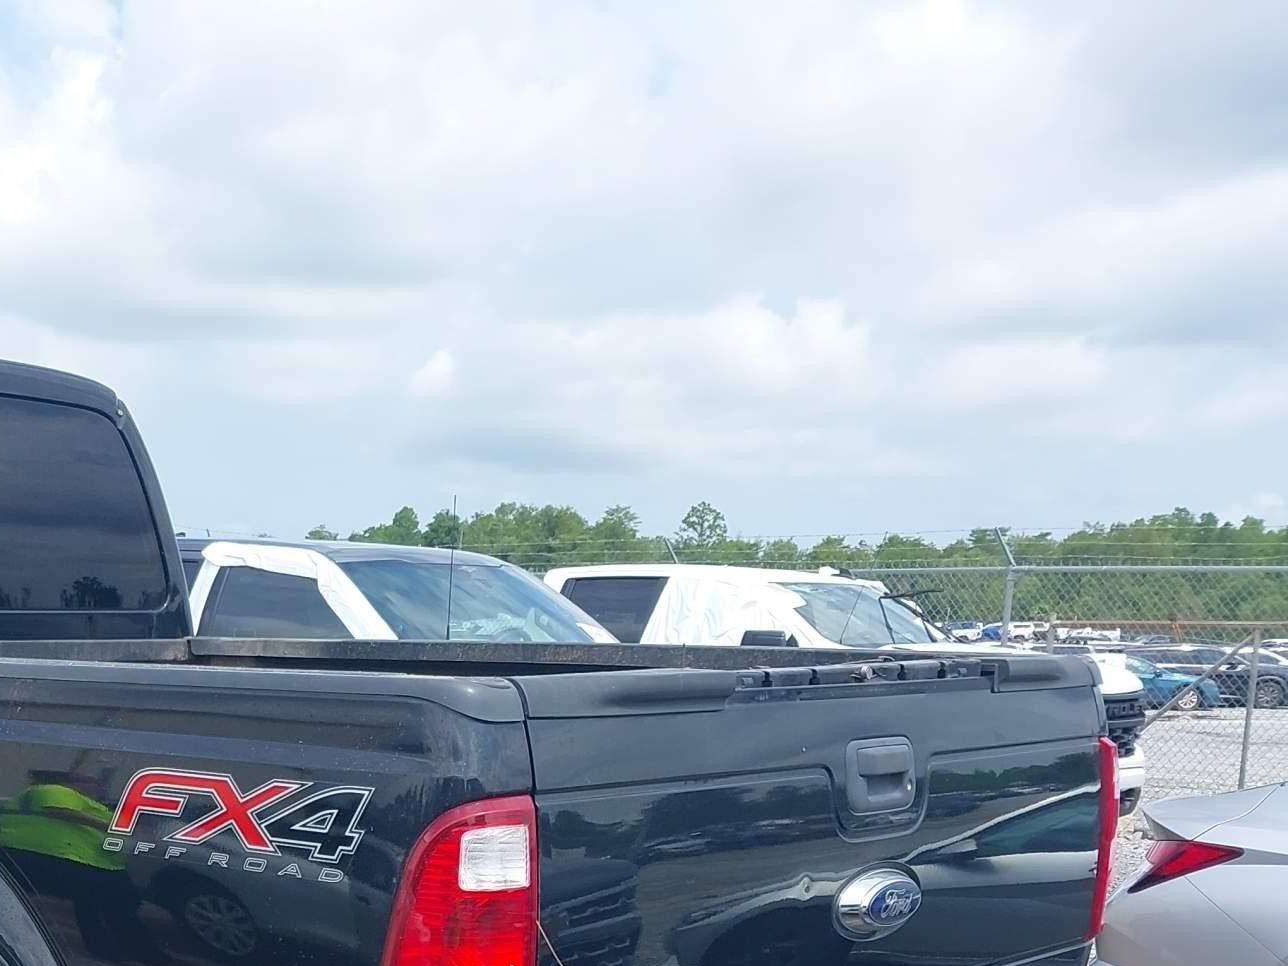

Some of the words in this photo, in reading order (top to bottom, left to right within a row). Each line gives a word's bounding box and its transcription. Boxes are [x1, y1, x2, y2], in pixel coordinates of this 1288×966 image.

[108, 767, 375, 863] FX4
[102, 837, 187, 869] OFF
[207, 852, 345, 884] ROAD
[881, 889, 920, 918] Ford
